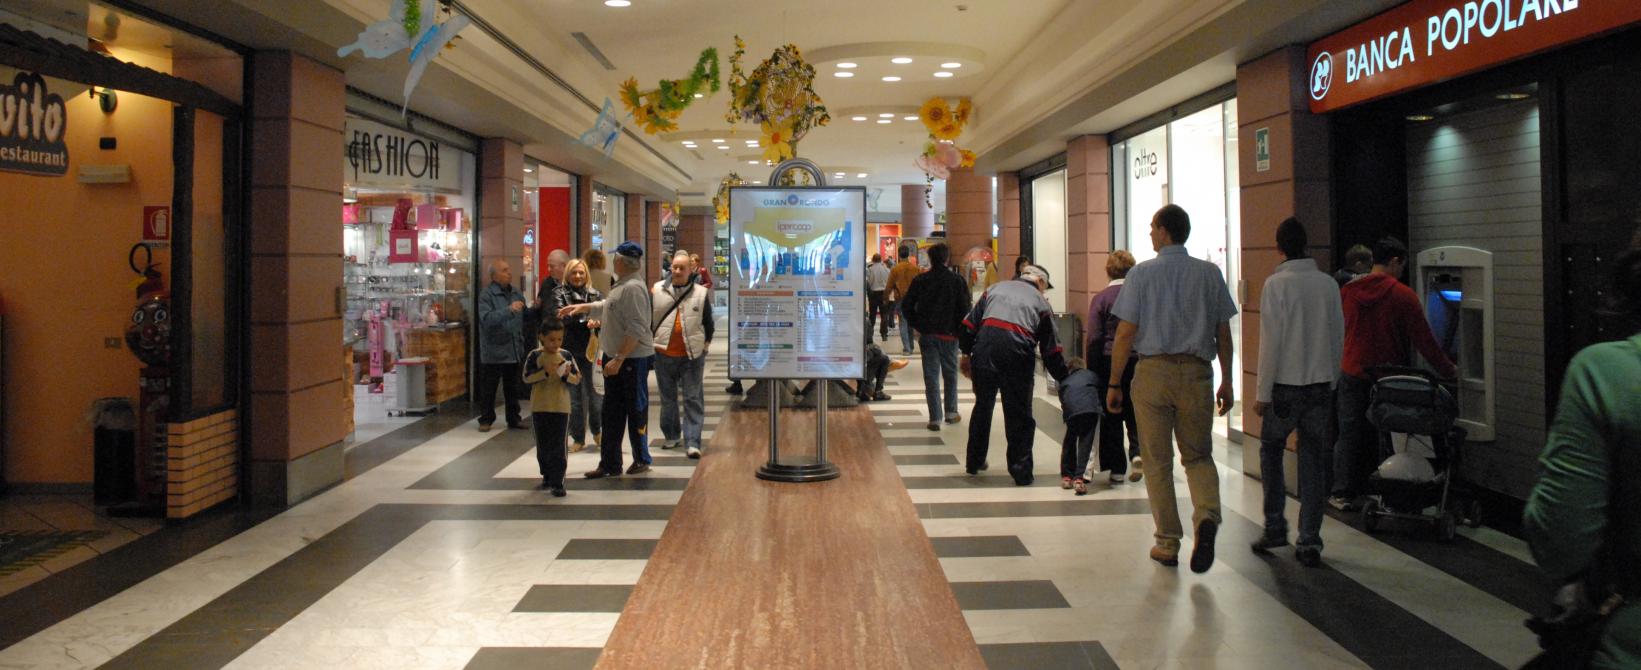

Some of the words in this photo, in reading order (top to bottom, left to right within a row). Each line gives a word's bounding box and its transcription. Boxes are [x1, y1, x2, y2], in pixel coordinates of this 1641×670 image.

[1346, 26, 1415, 83] BANCA
[1428, 0, 1579, 56] POPOLA
[348, 130, 439, 182] FASHION
[1134, 148, 1158, 179] oltre
